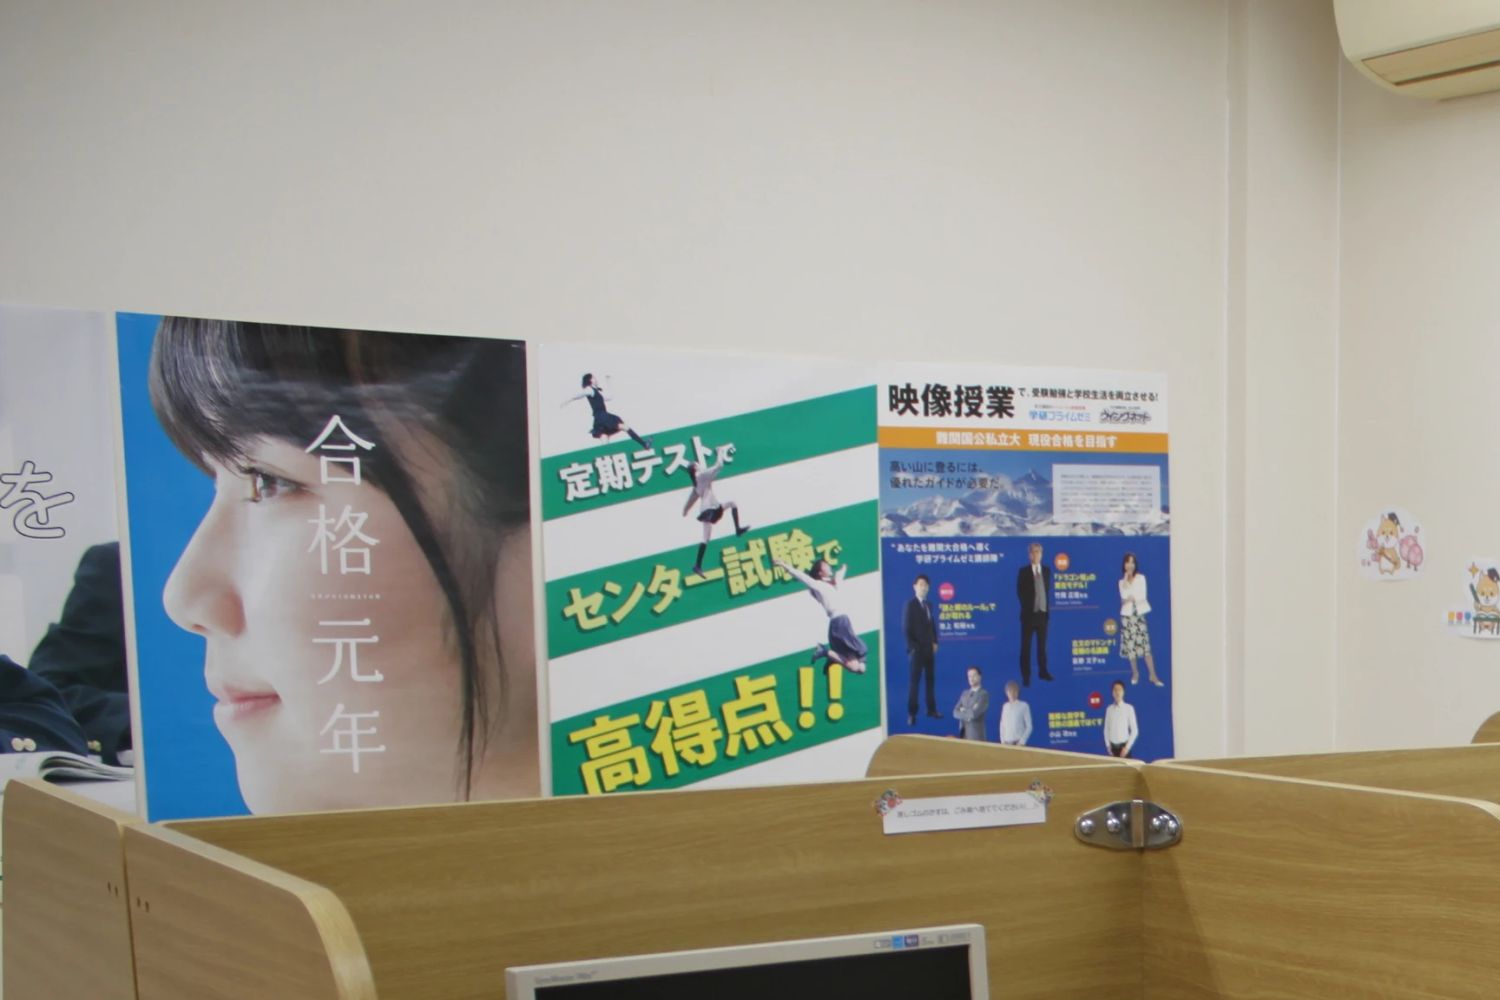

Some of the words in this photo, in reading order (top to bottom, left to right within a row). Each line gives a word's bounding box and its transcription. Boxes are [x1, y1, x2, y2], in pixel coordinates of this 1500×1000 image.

[888, 382, 1016, 418] 映像授業
[0, 460, 75, 539] を
[562, 528, 844, 632] センター試験で
[569, 663, 845, 796] 高得点!!
